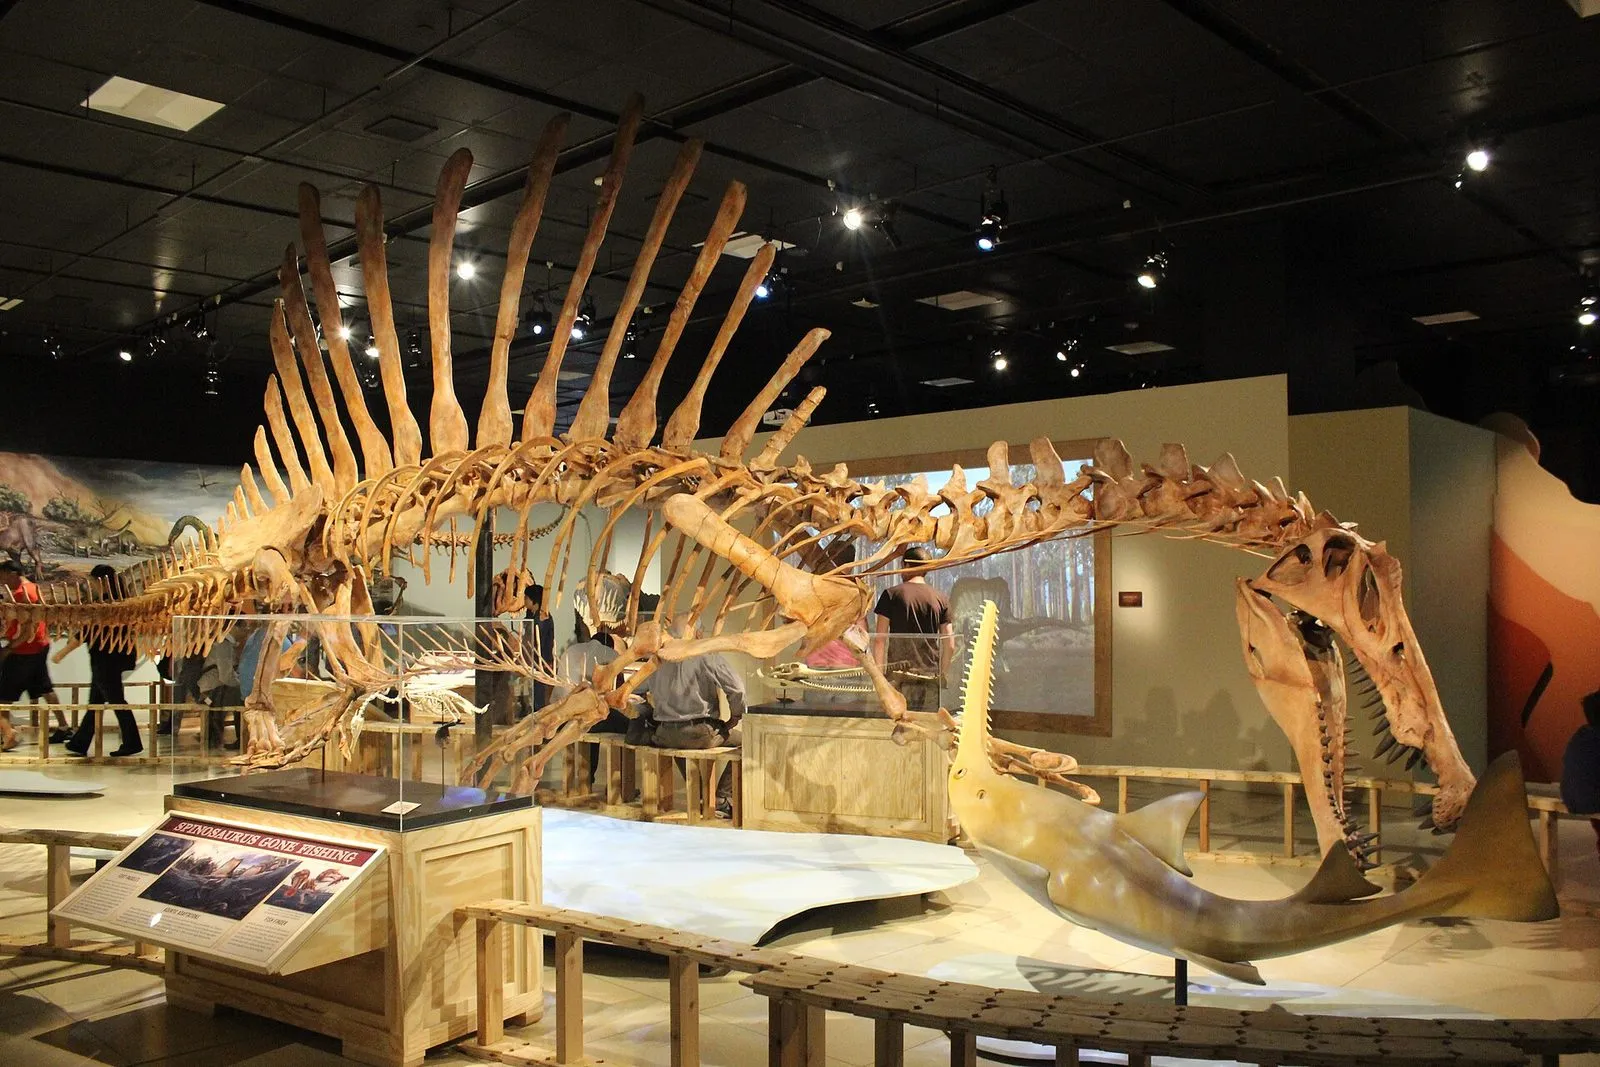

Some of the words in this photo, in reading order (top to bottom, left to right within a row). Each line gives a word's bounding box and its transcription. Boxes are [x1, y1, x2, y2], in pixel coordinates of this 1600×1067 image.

[174, 822, 260, 845] SPINOSAURUS
[259, 837, 300, 852] GONE
[297, 845, 358, 862] FISHING
